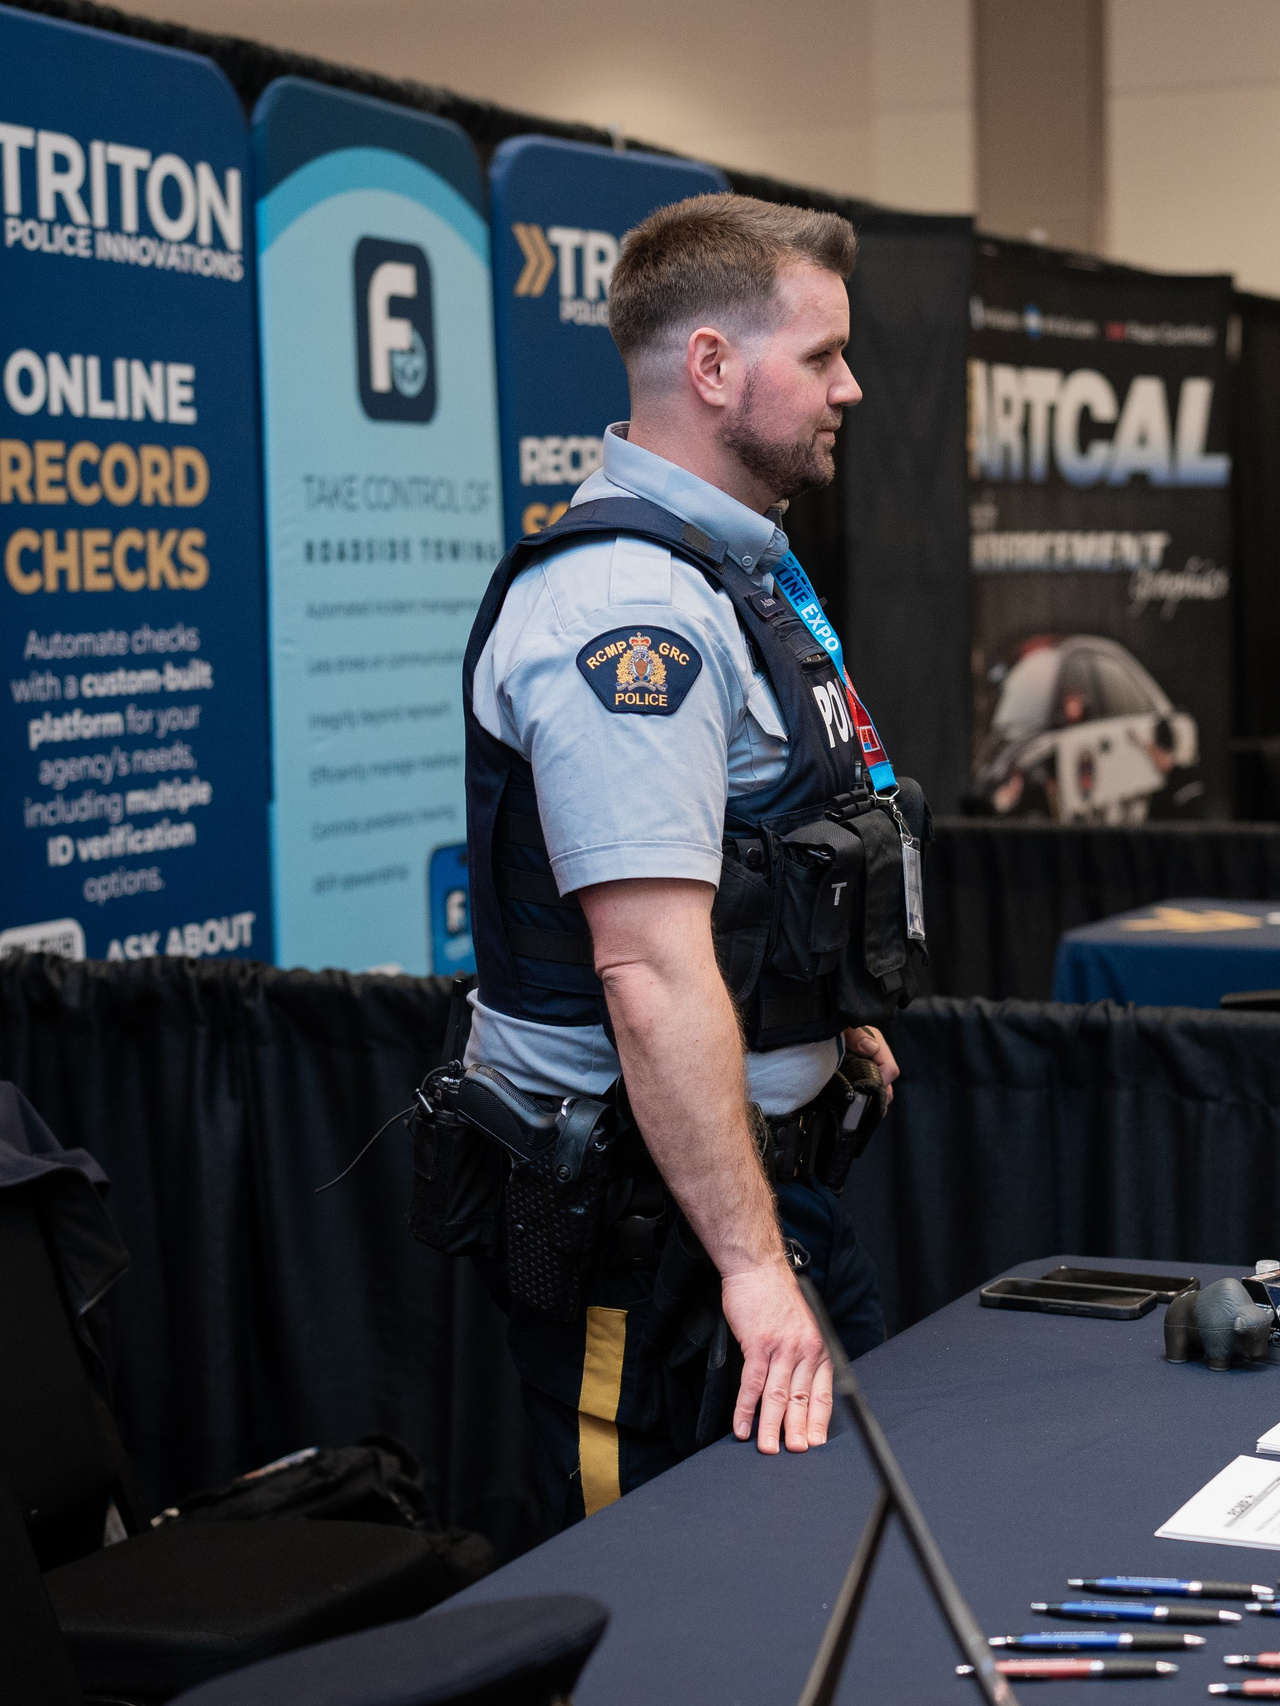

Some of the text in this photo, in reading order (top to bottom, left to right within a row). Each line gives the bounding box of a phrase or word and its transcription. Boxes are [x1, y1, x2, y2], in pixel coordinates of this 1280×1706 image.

[0, 121, 243, 252] TRITON
[5, 217, 244, 282] POLICE INNOVATIONS
[4, 348, 197, 425] ONLINE
[0, 438, 210, 507] RECORD
[303, 475, 359, 512] TAKE
[364, 475, 461, 515] CONTROL
[4, 527, 210, 595] CHECKS
[304, 536, 410, 565] ROADSIDE
[775, 568, 810, 607] LINE
[801, 603, 839, 651] EXPO
[24, 622, 201, 660] Automate checks
[586, 641, 690, 669] RCMP GRC
[10, 658, 214, 703] with a custom-built
[615, 693, 668, 706] POLICE
[28, 703, 201, 750] platform for your
[24, 776, 212, 828] including multiple
[47, 817, 197, 867] ID verification
[831, 882, 847, 906] T
[106, 930, 161, 962] ASK
[164, 911, 256, 958] ABOUT
